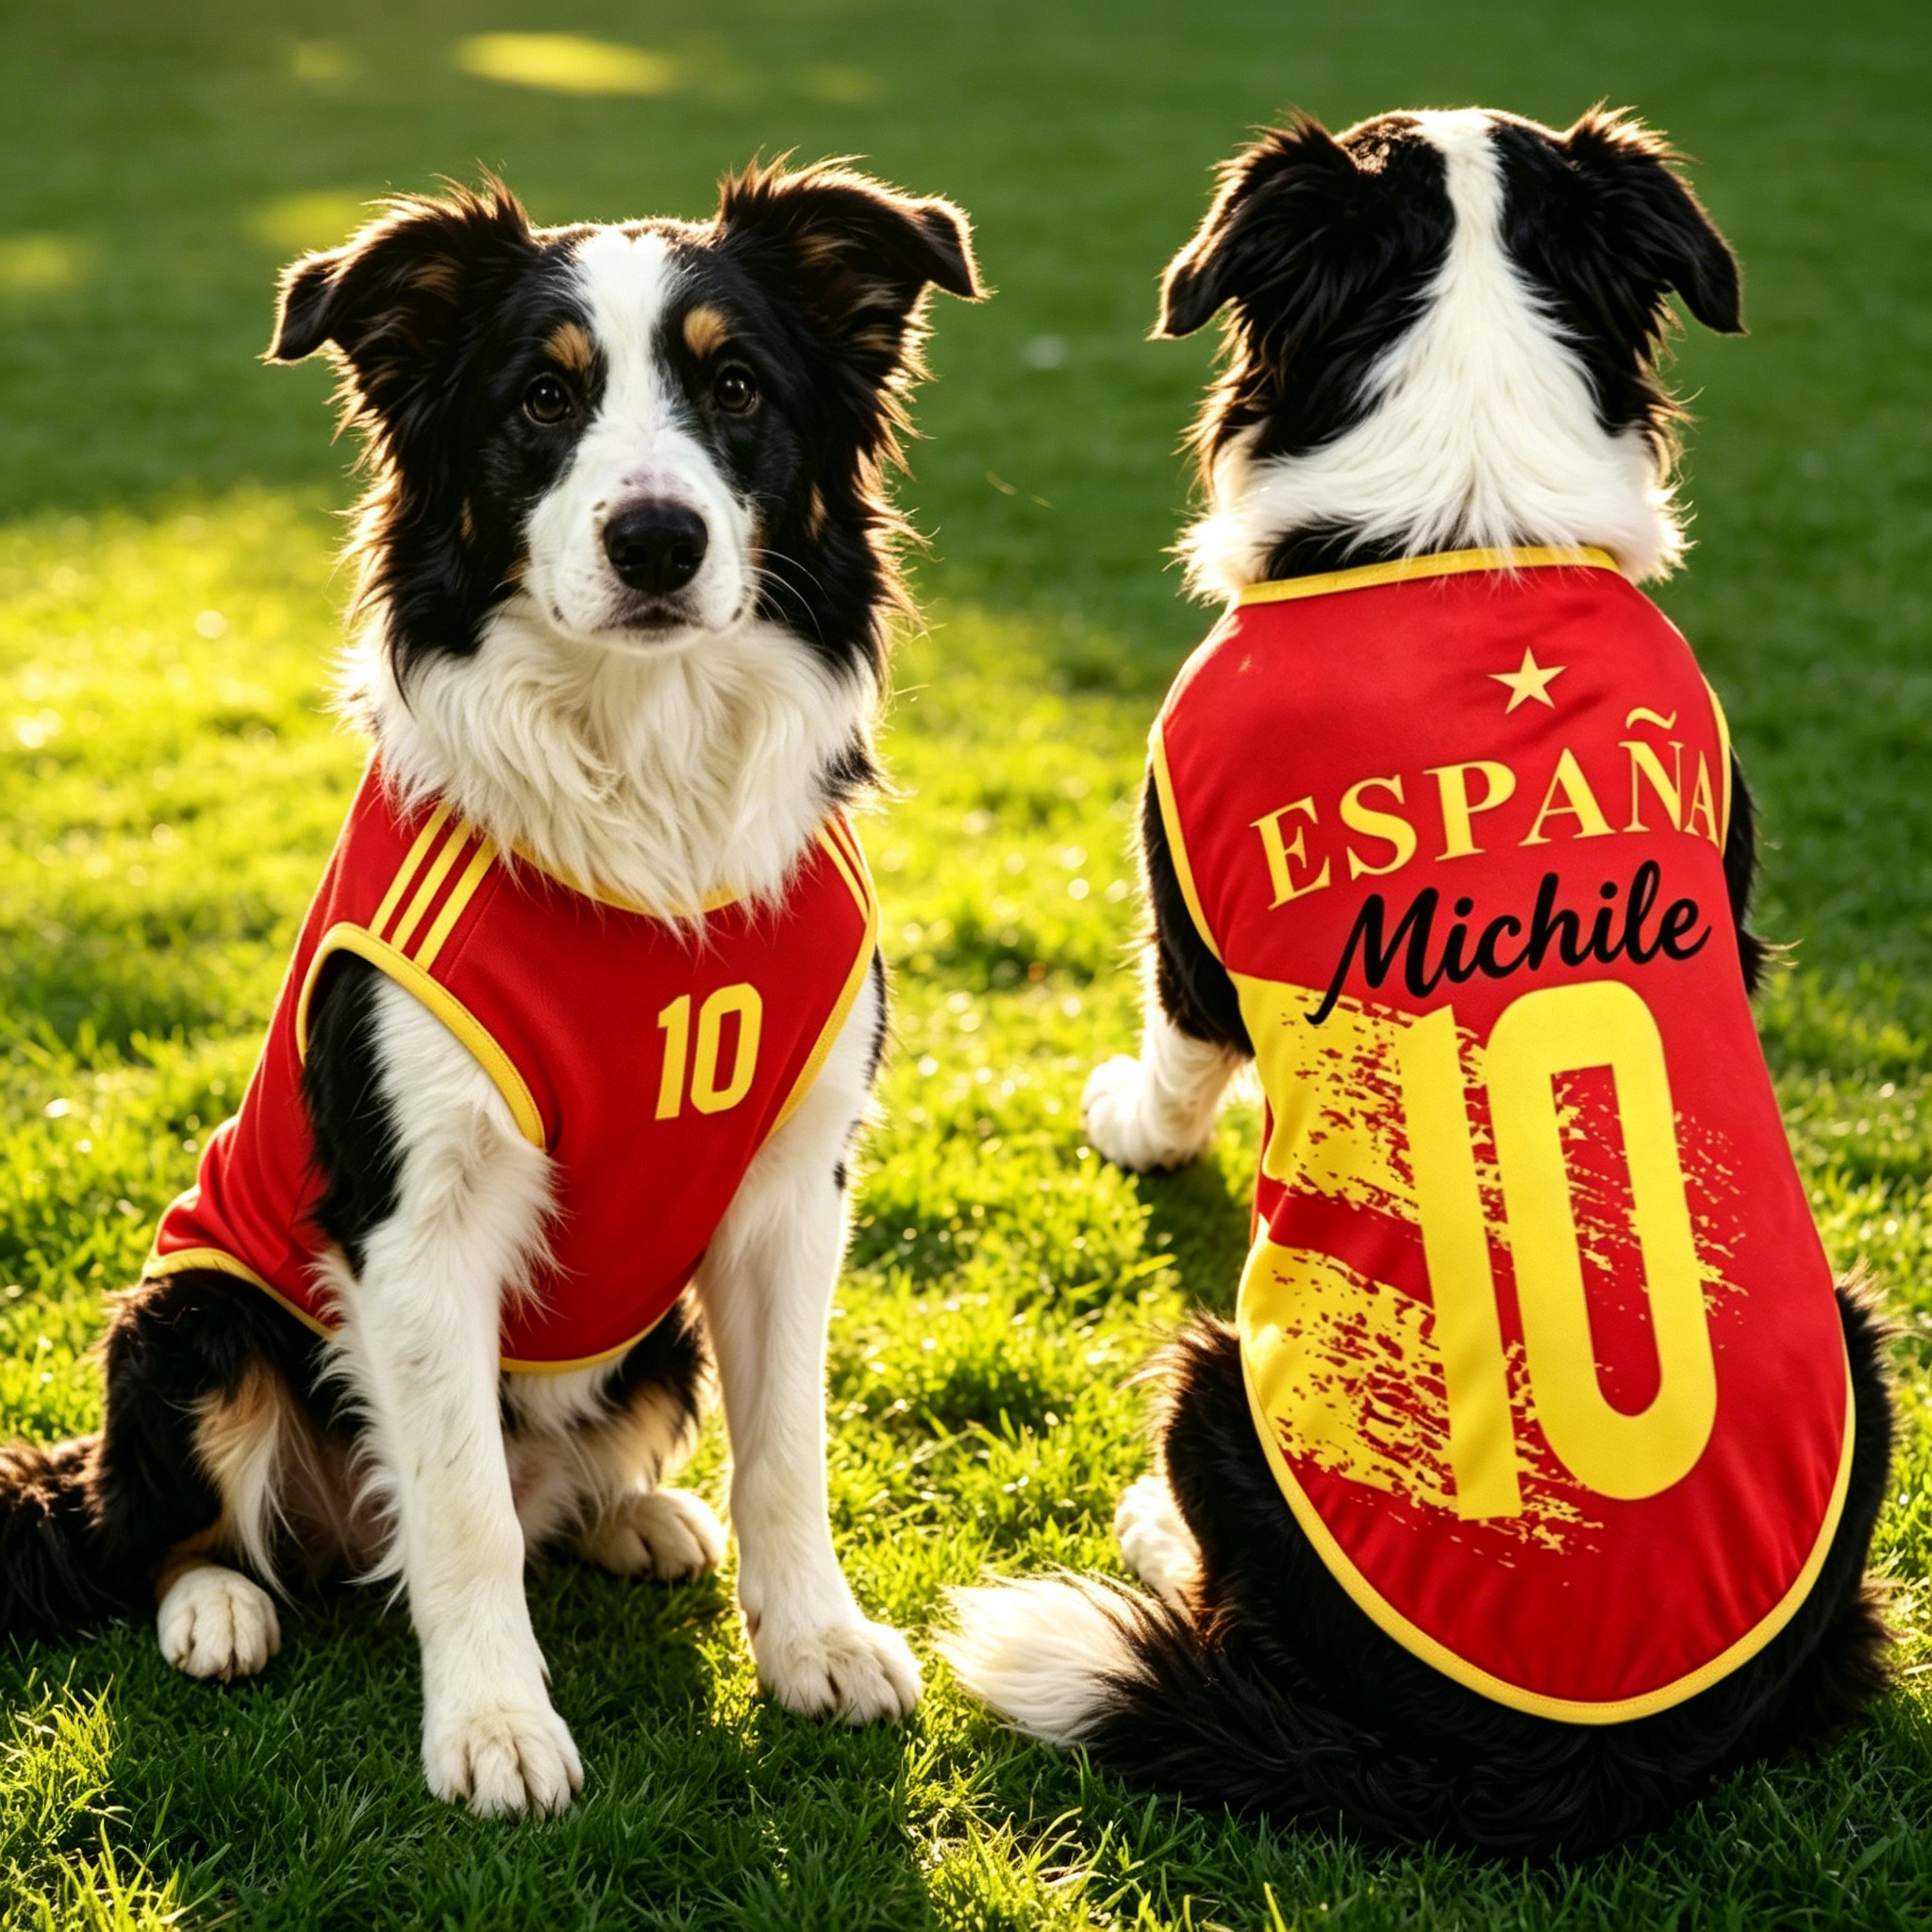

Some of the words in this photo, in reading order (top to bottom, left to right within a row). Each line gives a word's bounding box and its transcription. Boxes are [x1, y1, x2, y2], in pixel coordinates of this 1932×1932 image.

[1249, 707, 1720, 911] ESPAÑA
[1303, 859, 1712, 1026] Michile
[655, 982, 763, 1121] 10
[1398, 979, 1717, 1522] 10
